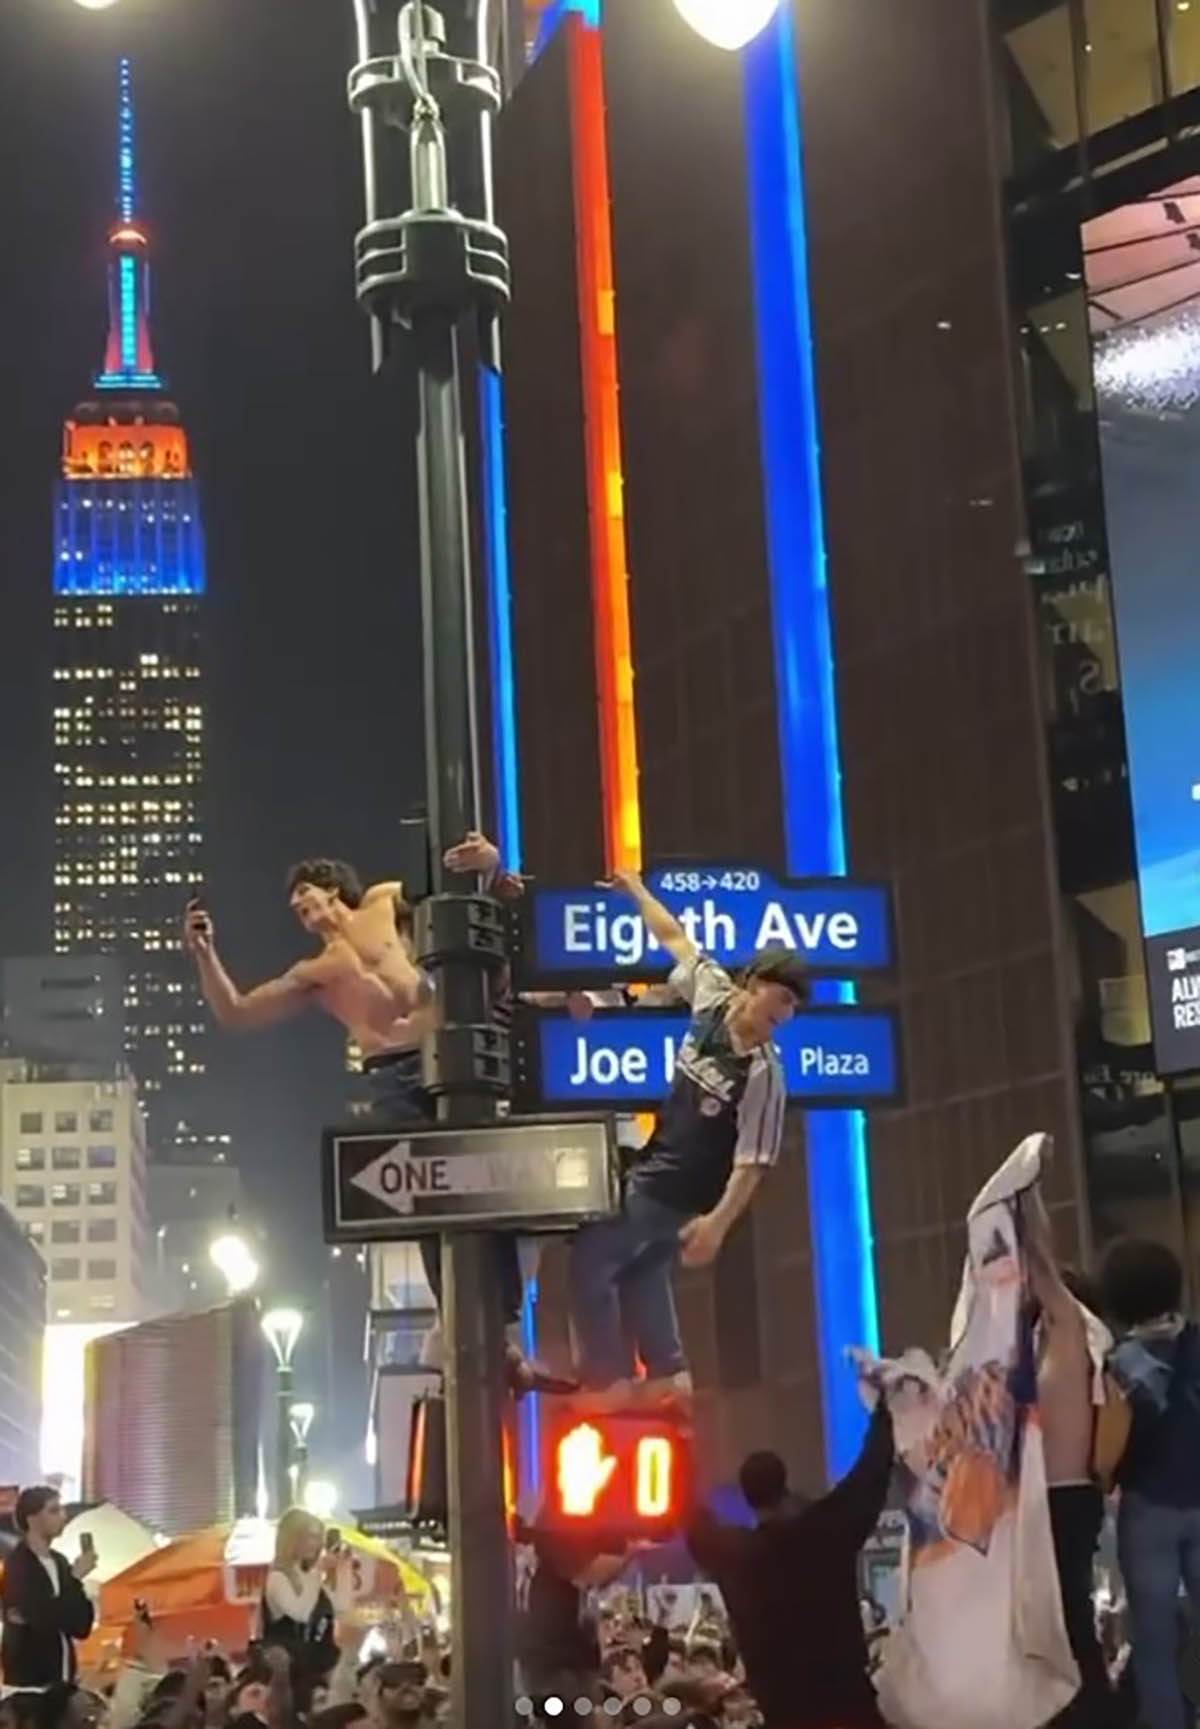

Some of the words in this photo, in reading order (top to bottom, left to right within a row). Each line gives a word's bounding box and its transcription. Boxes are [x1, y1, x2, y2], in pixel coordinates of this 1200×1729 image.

[564, 899, 737, 965] Eigth
[754, 901, 859, 949] Ave
[569, 1036, 648, 1085] Joe
[800, 1045, 870, 1075] Plaza
[380, 1160, 451, 1195] ONE
[637, 1436, 671, 1517] 0
